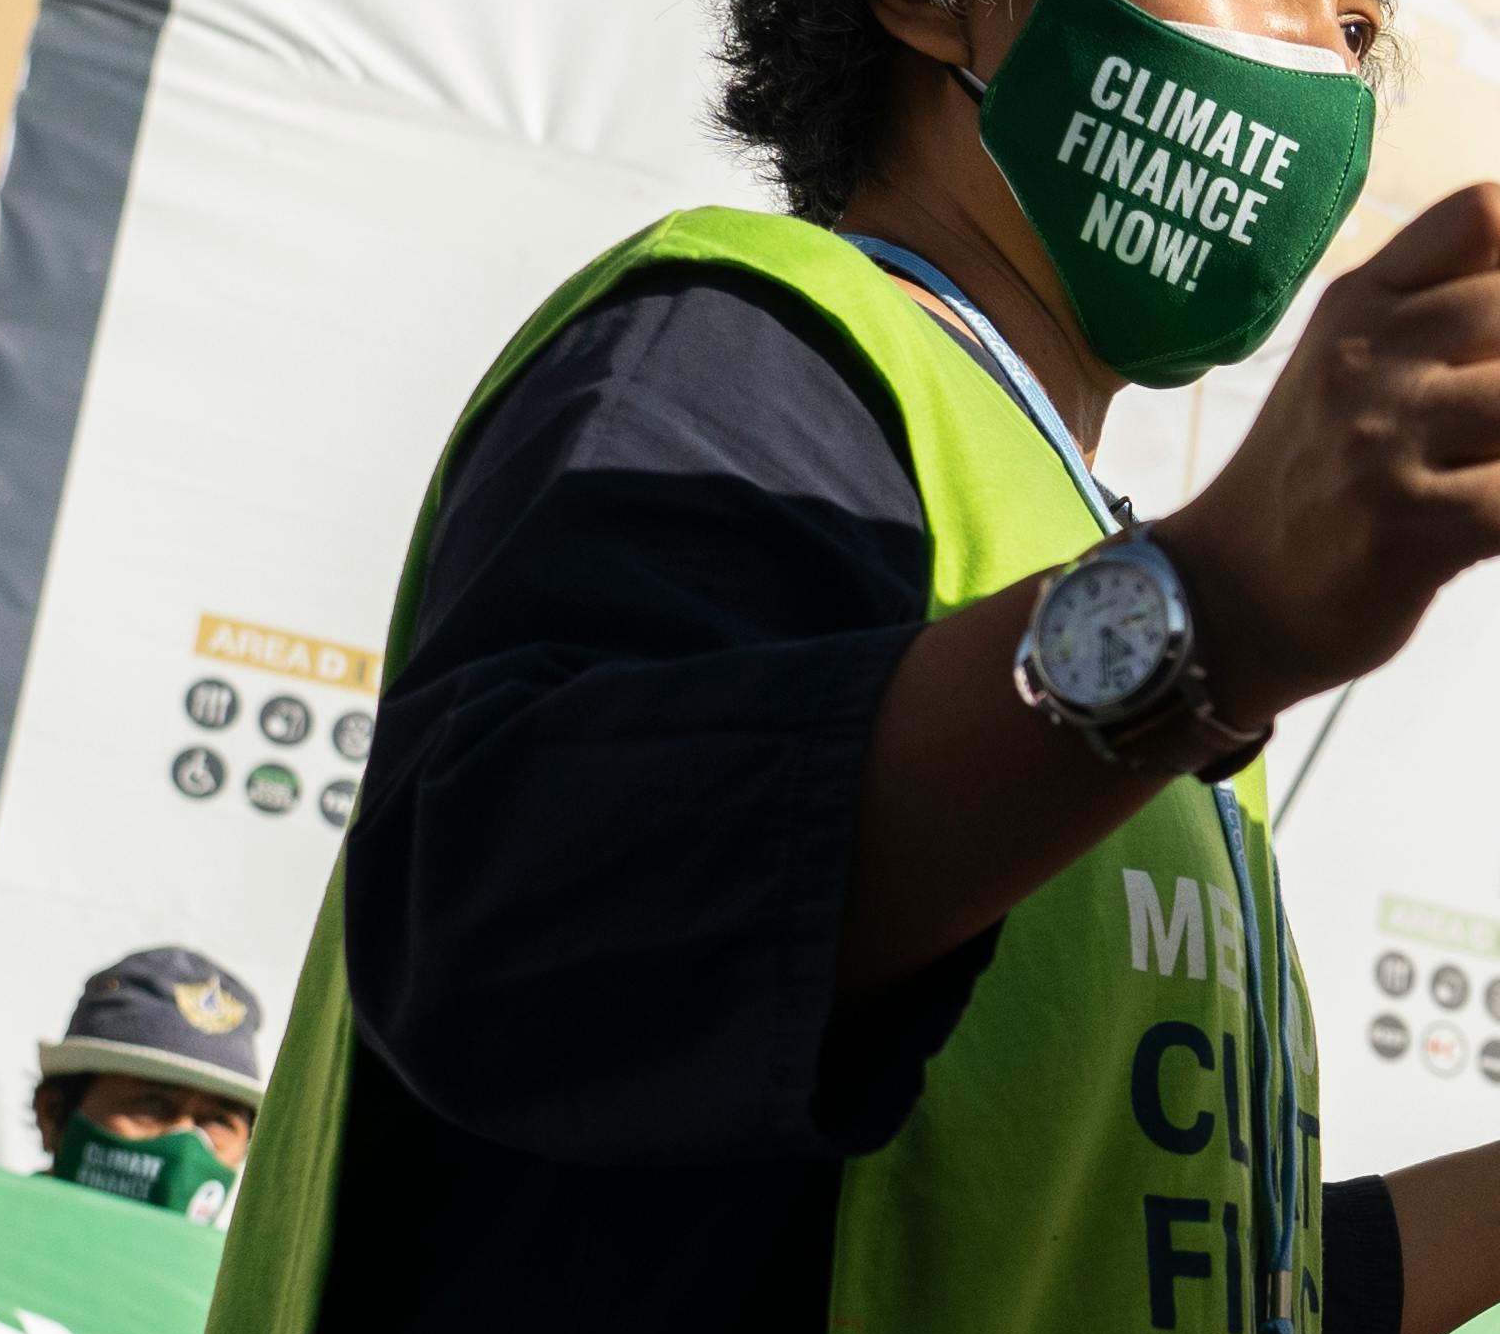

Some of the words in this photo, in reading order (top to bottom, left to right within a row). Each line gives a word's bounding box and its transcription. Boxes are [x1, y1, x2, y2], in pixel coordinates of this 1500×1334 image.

[1056, 110, 1269, 247] FINANCE
[1090, 55, 1301, 191] CLIMATE
[1079, 192, 1213, 294] NOW!
